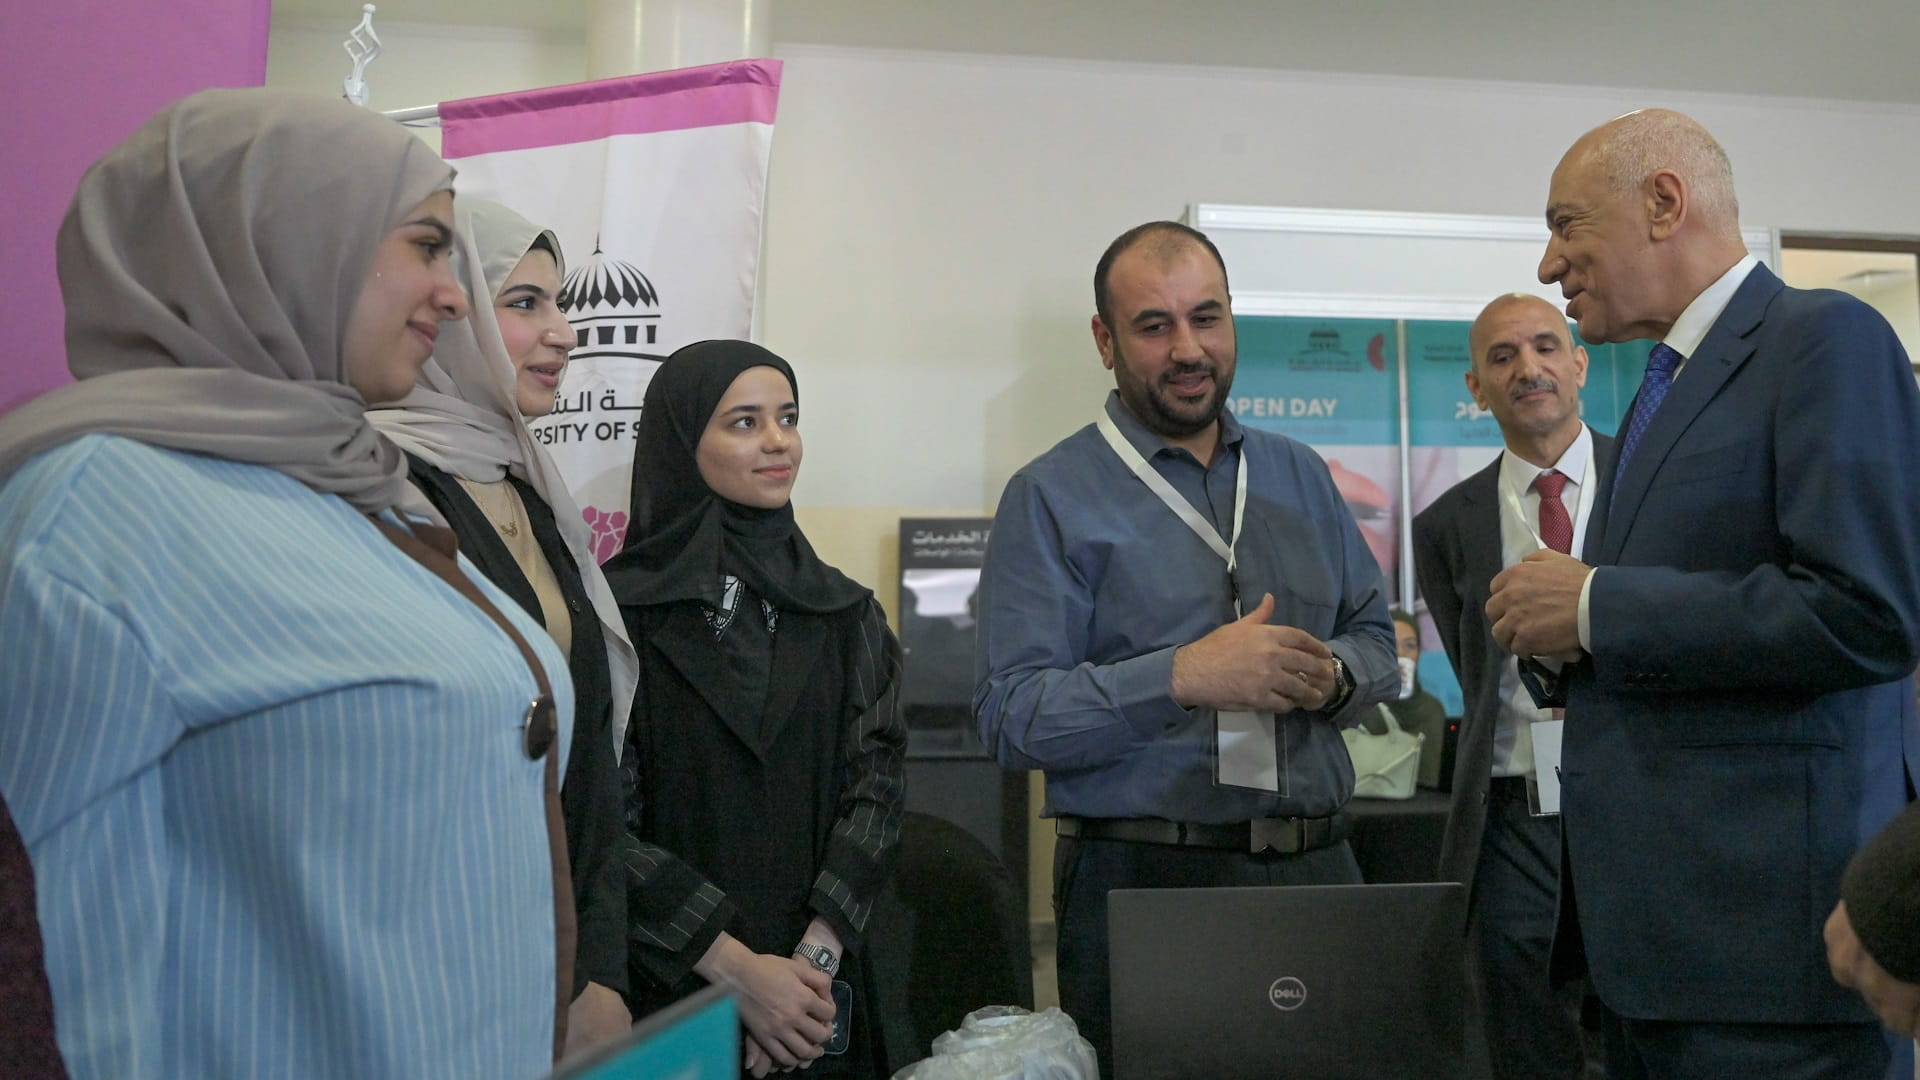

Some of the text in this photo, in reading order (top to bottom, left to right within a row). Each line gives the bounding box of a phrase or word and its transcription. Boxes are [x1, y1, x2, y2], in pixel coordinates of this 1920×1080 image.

[1290, 398, 1338, 417] DAY
[534, 423, 589, 445] RSITY
[595, 422, 626, 441] OF
[1274, 989, 1303, 999] DELL
